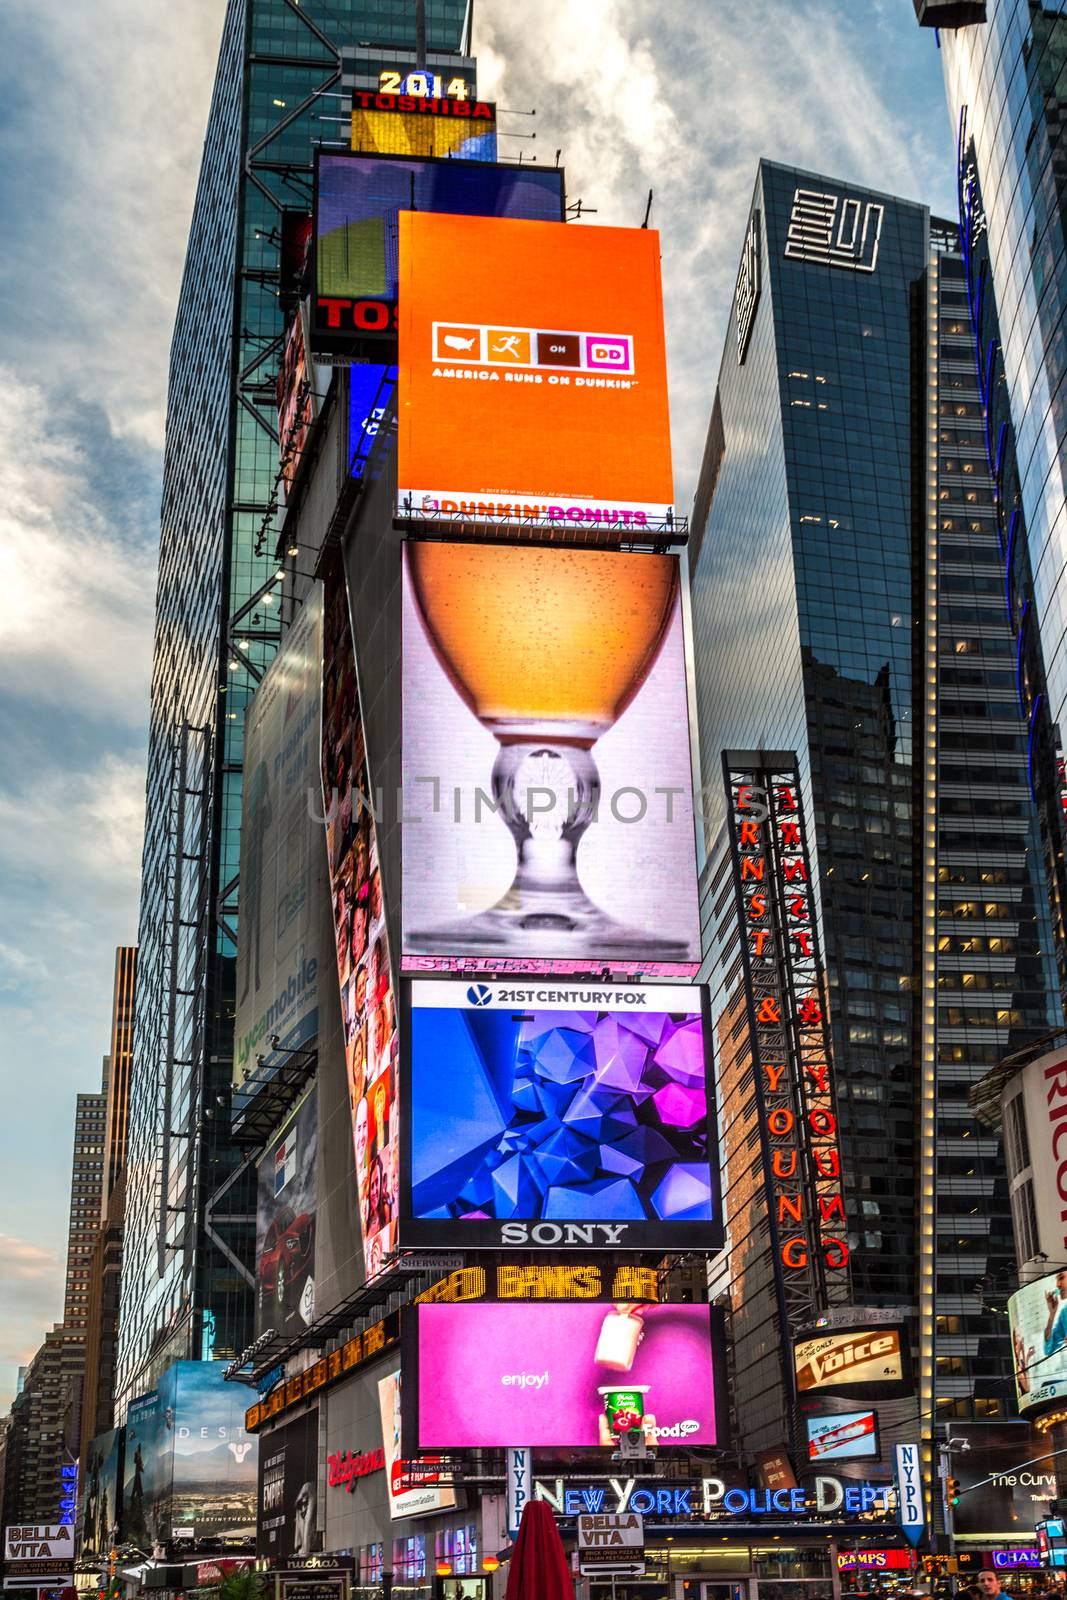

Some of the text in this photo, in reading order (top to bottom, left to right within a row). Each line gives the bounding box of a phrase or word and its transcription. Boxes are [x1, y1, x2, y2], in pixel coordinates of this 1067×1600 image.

[379, 71, 469, 101] 2014
[355, 91, 492, 118] TOSHIBA
[596, 348, 621, 359] DD
[432, 368, 500, 381] AMERICA
[504, 372, 543, 384] RUNS
[548, 375, 570, 385] ON
[441, 500, 648, 526] DUNKIN' DONUTS
[498, 990, 647, 1005] 21ST CENTURY FOX
[737, 786, 808, 1269] ERNST & YOUNG
[501, 1223, 628, 1245] SONY
[401, 1257, 462, 1268] SHERWOOD
[809, 1336, 894, 1384] Voice
[501, 1371, 549, 1389] enjoy!
[1030, 1388, 1049, 1402] CHASE
[901, 1447, 918, 1522] NYPD
[534, 1479, 604, 1514] NEW
[609, 1478, 691, 1514] YORK
[702, 1478, 806, 1514] POLICE
[581, 1515, 640, 1530] BELLA
[8, 1526, 70, 1541] BELLA
[583, 1531, 624, 1545] VITA
[8, 1543, 52, 1558] VITA
[287, 1556, 340, 1569] nuchas
